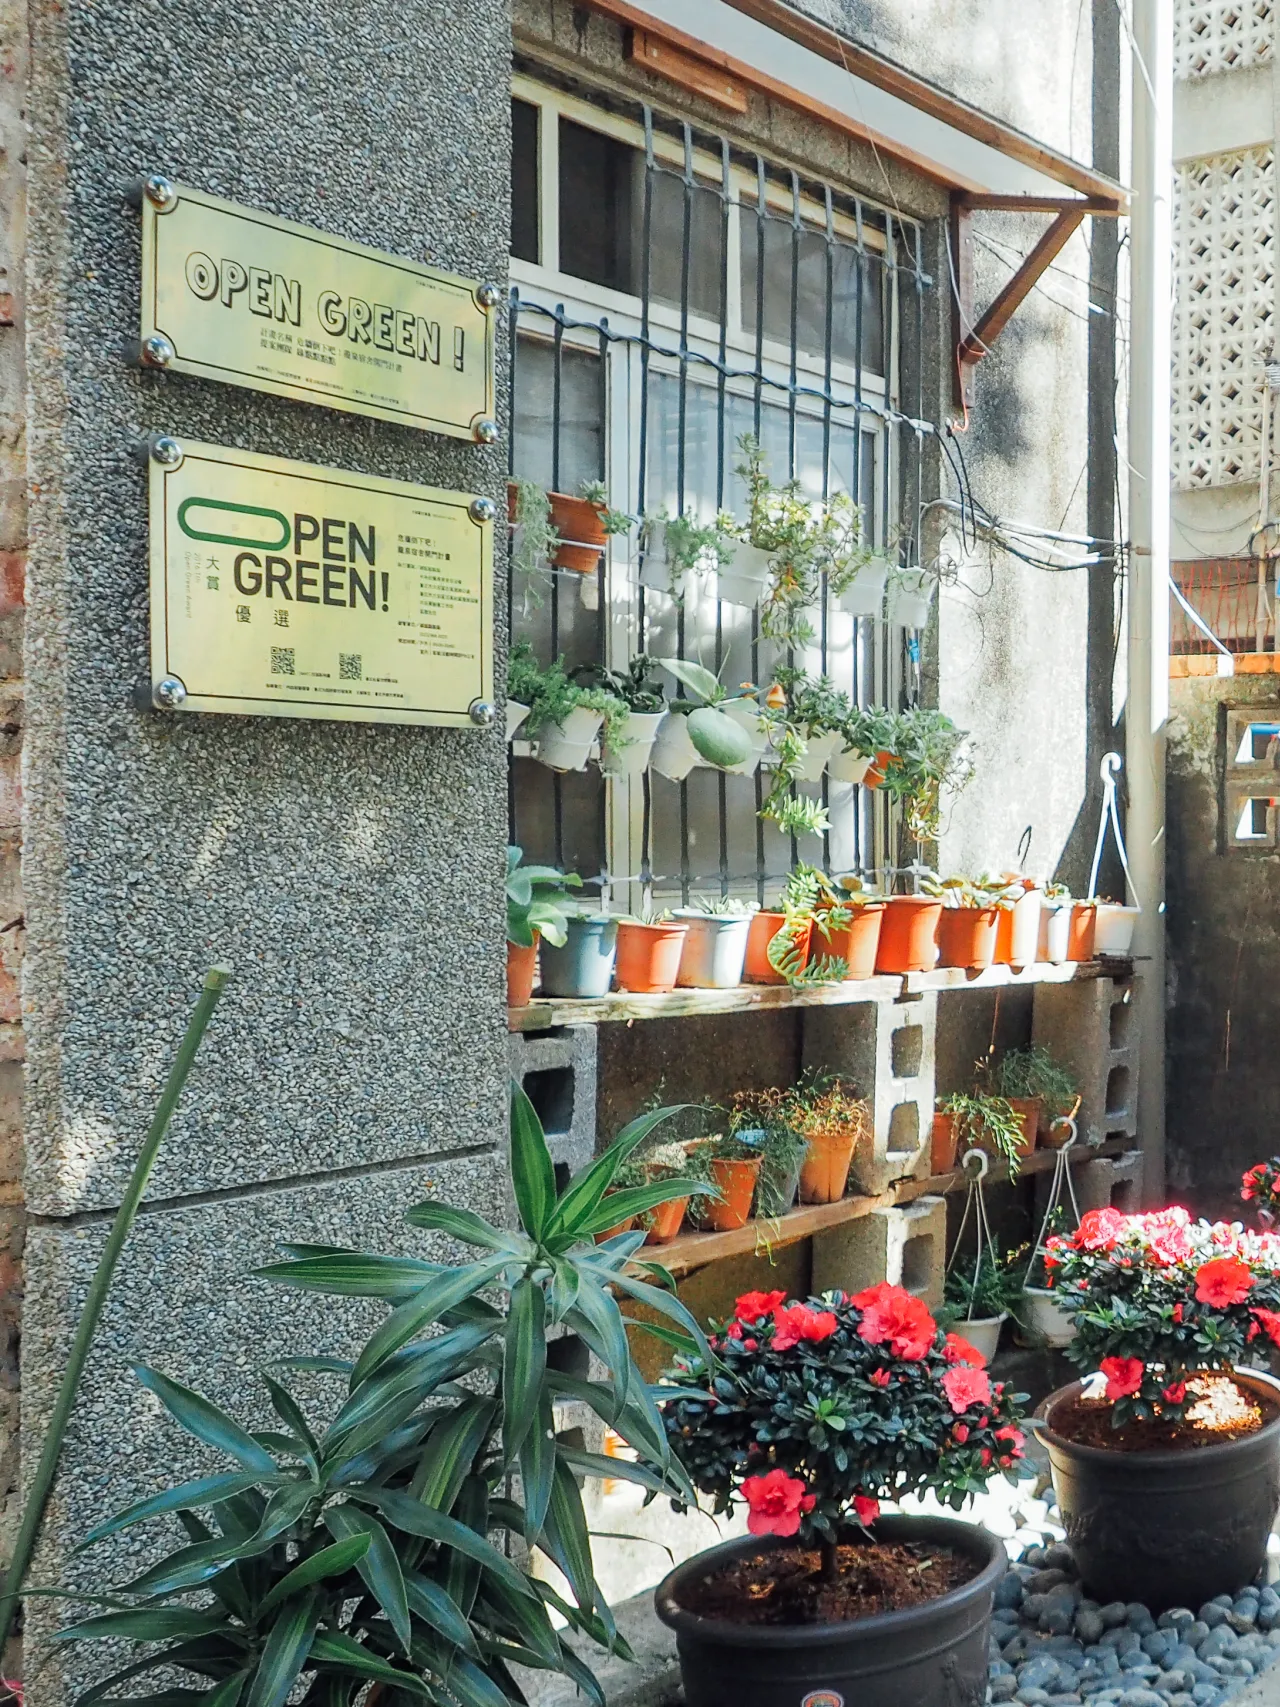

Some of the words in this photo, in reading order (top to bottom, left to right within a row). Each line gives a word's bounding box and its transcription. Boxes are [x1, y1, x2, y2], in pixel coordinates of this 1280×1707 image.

[185, 251, 301, 327] OPEN
[316, 290, 441, 366] GREEN
[177, 496, 376, 566] OPEN
[206, 555, 220, 591] 大賞
[233, 551, 390, 613] GREEN!
